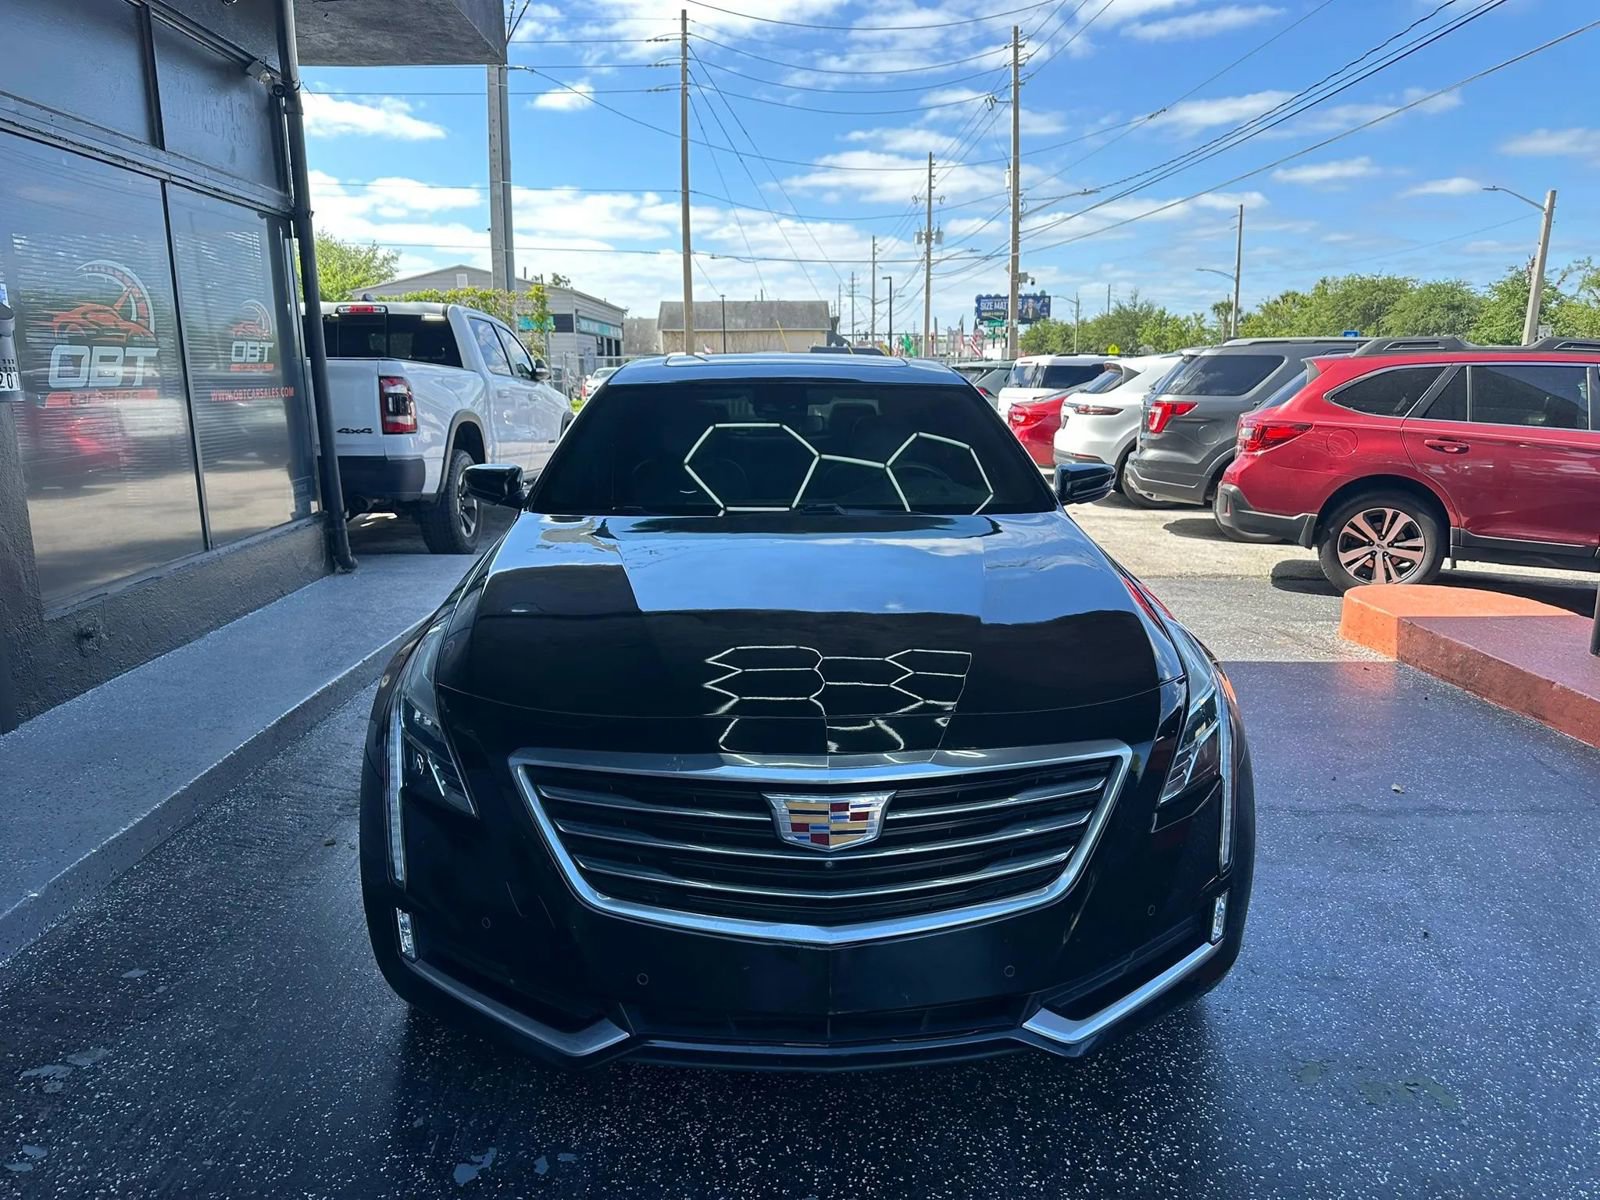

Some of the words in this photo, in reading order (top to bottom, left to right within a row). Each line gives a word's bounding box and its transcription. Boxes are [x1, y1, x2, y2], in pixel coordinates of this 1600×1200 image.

[981, 301, 993, 311] SIZE
[231, 340, 275, 362] OBT
[48, 344, 160, 388] OBT
